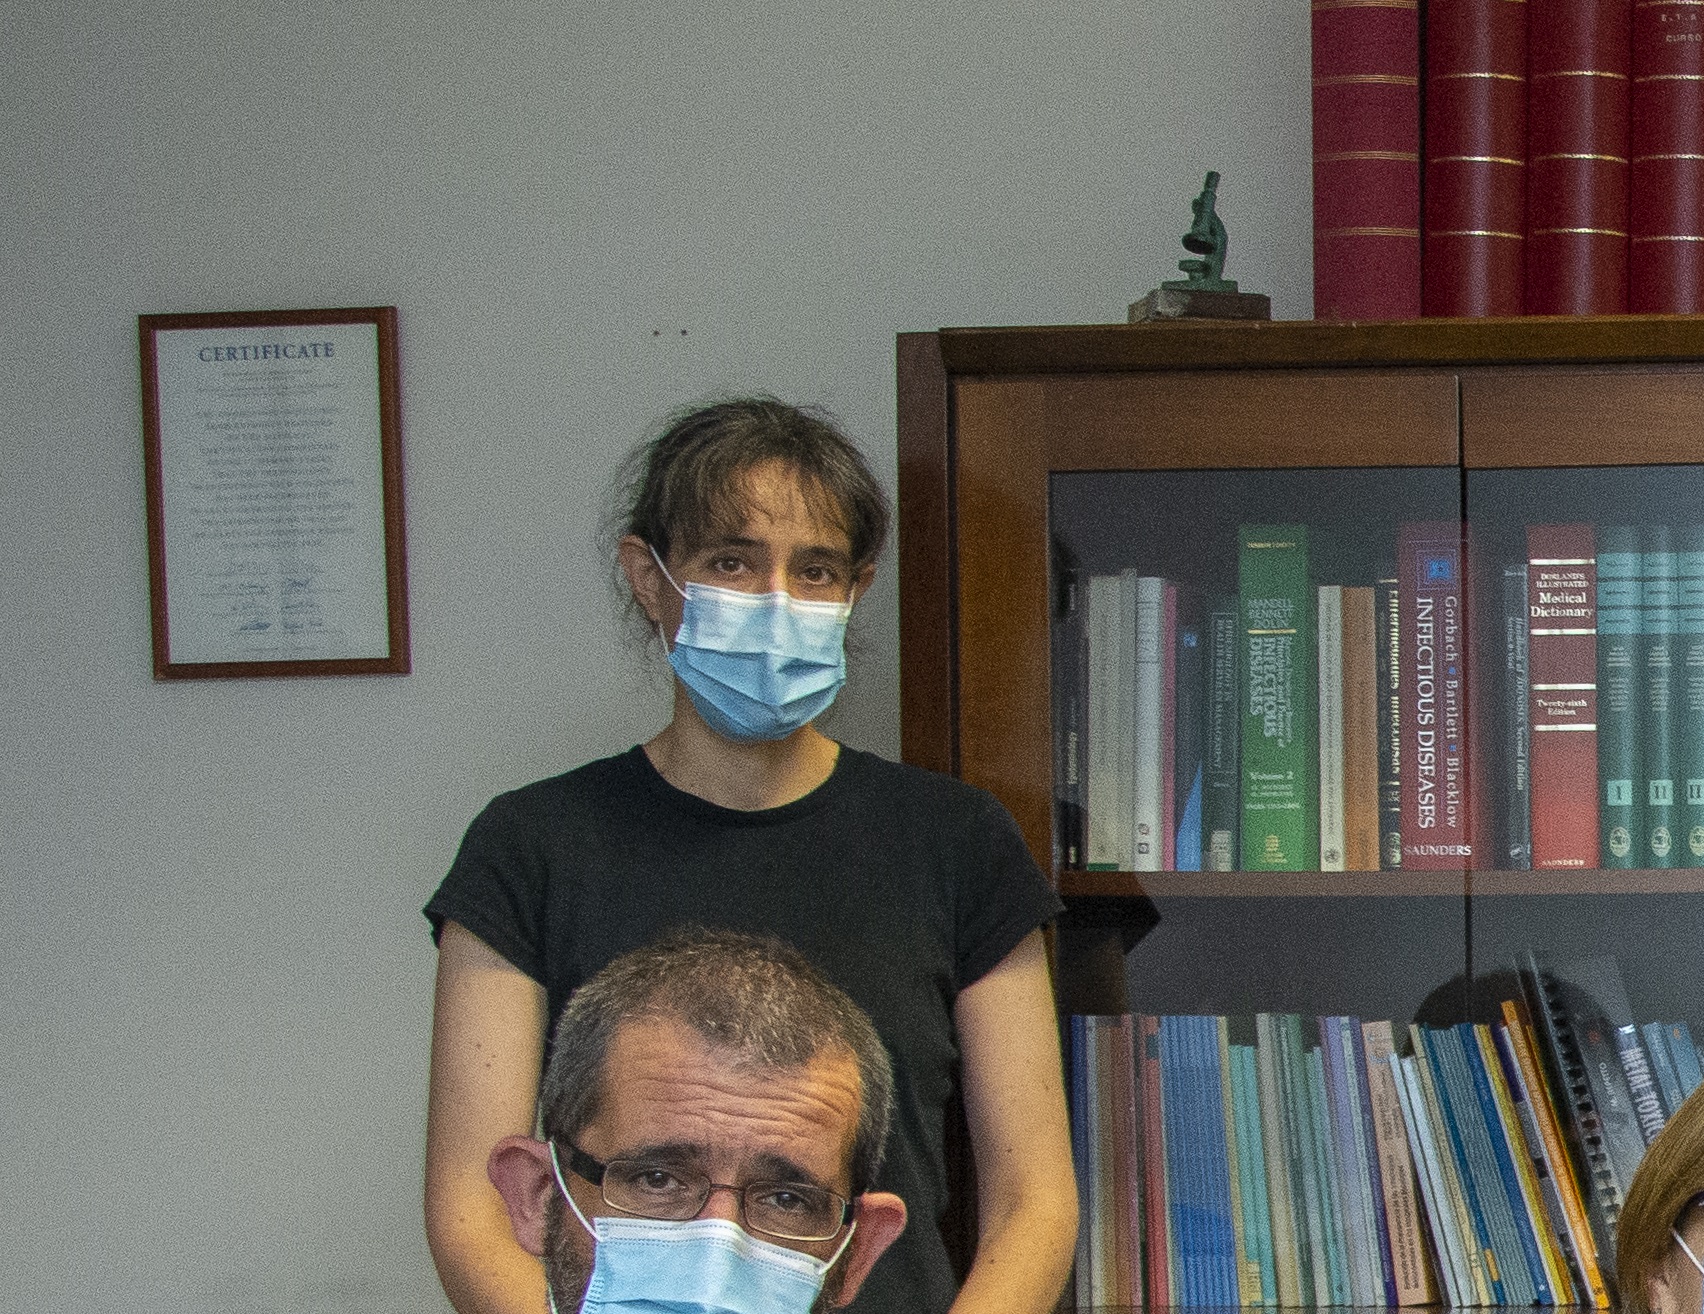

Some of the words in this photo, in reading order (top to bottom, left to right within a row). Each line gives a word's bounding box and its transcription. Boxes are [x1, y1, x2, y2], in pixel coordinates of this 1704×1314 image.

[1666, 33, 1702, 43] CURSO
[198, 342, 336, 363] CERTIFICATE
[1536, 580, 1589, 589] ILLUSTRATED
[1539, 592, 1586, 604] Medical
[1530, 605, 1594, 619] Dictionary
[1444, 595, 1458, 662] Gorbach
[1515, 616, 1525, 661] Handbook
[1224, 619, 1233, 688] EPIDEMIOLOGY
[1416, 597, 1435, 725] INFECTIOUS
[1250, 637, 1263, 715] DISEASES
[1515, 663, 1525, 673] of
[1263, 637, 1276, 737] INFECTIOUS
[1277, 684, 1286, 702] and
[1445, 679, 1458, 740] Bartlett
[1536, 698, 1588, 709] Twenty-sixth
[1547, 707, 1576, 716] Edition
[1213, 704, 1223, 769] MANAGEMENT
[1277, 738, 1286, 747] of
[1516, 726, 1525, 757] Second
[1286, 771, 1294, 779] 2
[1417, 729, 1436, 829] DISEASES
[1516, 758, 1525, 791] Edition
[1446, 757, 1459, 828] Blacklow
[1653, 784, 1669, 800] II
[1404, 844, 1472, 857] SAUNDERS
[1541, 858, 1585, 867] SAUNDERS
[1619, 1047, 1654, 1093] METAL
